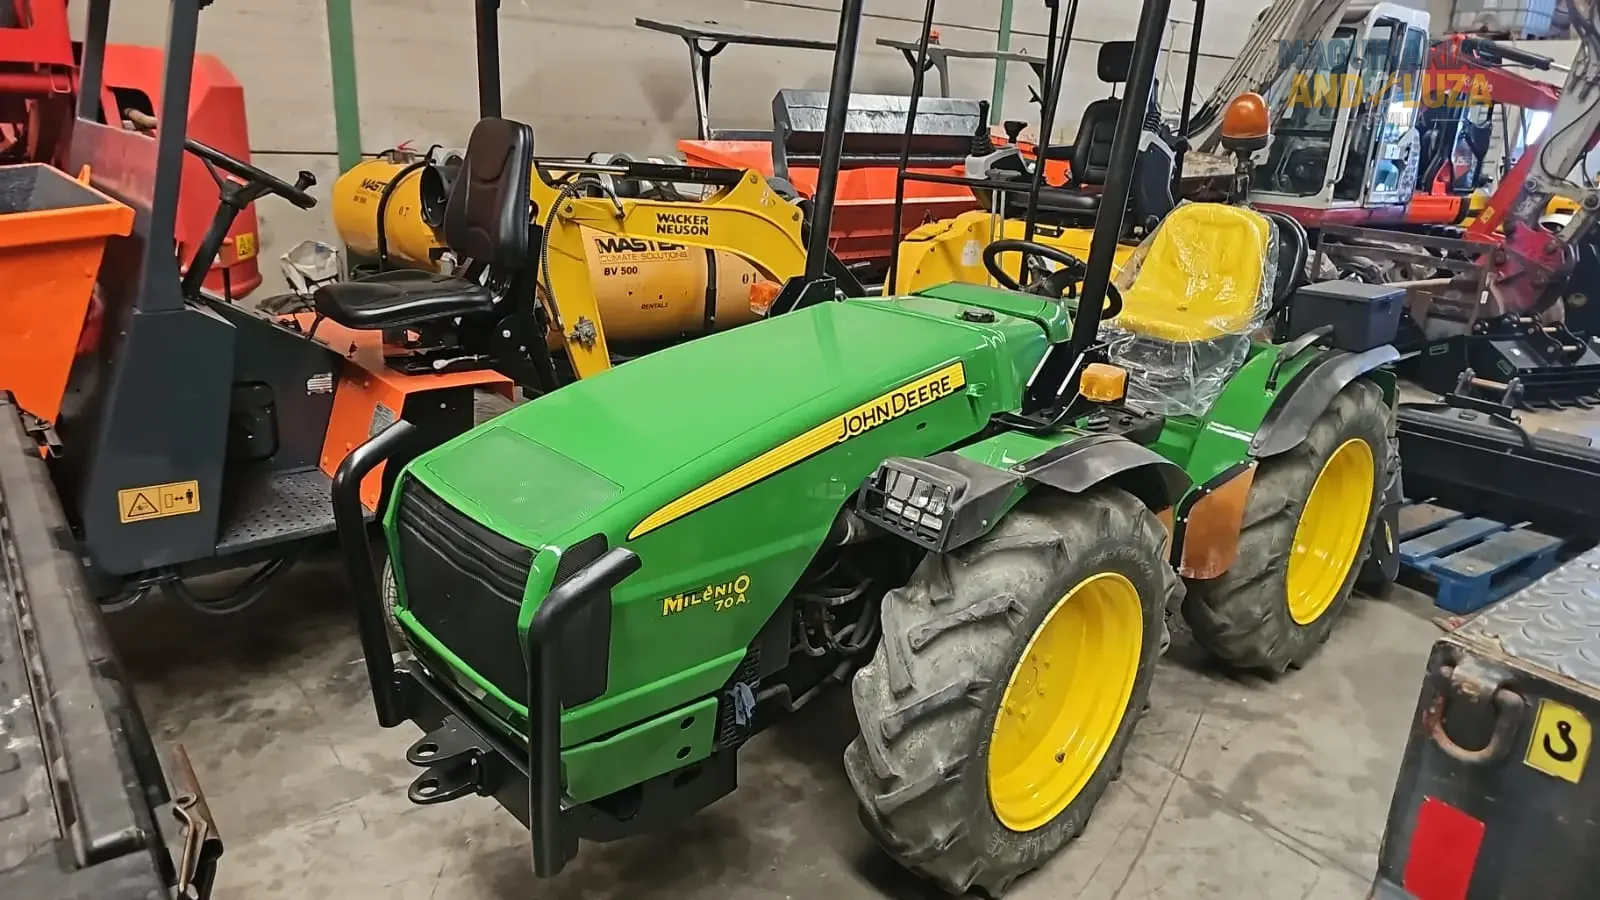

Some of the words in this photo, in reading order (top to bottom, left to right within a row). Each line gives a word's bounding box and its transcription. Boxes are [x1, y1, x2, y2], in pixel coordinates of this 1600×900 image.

[361, 178, 389, 194] MAST
[656, 213, 709, 225] WACKER
[656, 224, 709, 236] NEUSON
[600, 253, 638, 263] CLIMATE
[641, 252, 688, 261] SOLUTIONS
[603, 267, 618, 276] BV
[620, 266, 638, 275] 500
[641, 302, 669, 310] RENTALS
[837, 402, 890, 440] JOHN
[891, 375, 952, 414] DEERE
